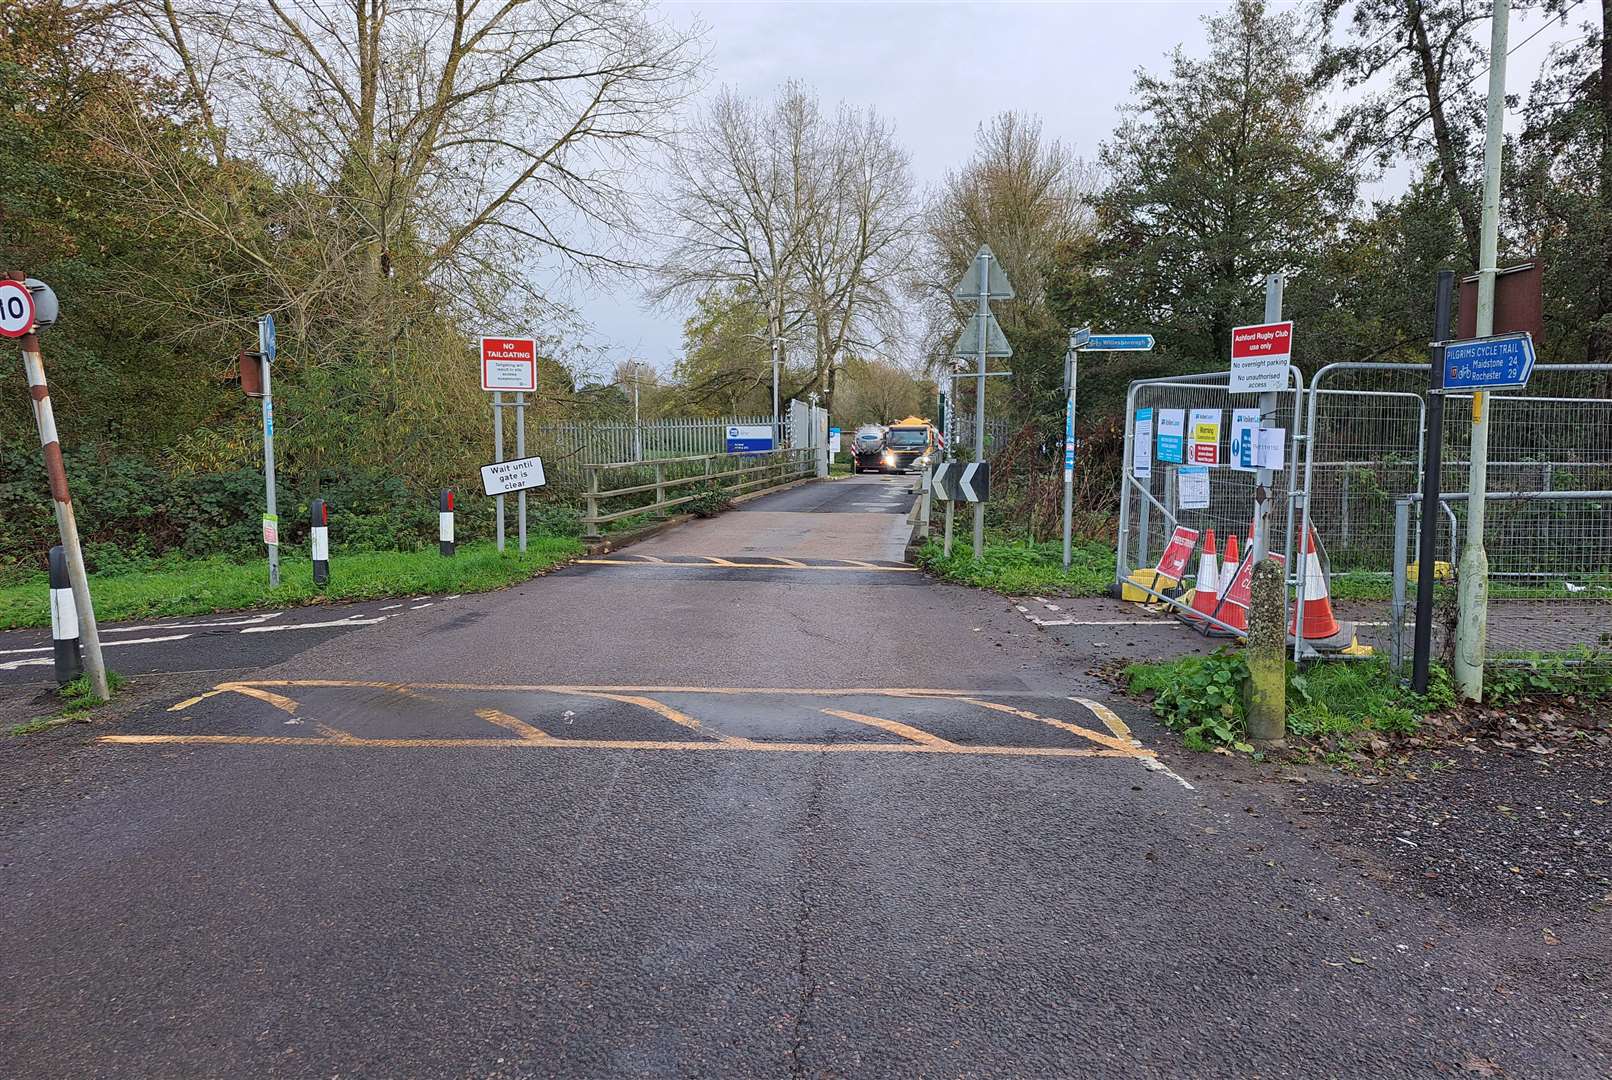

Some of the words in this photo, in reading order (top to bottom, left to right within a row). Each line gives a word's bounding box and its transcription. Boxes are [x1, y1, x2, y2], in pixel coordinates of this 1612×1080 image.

[1235, 333, 1256, 342] Ashford
[1257, 331, 1274, 340] Rugby
[1275, 330, 1289, 338] Club
[1260, 342, 1272, 350] only
[1447, 347, 1475, 360] PILGRIMS
[1476, 345, 1498, 357] CYCLE
[1499, 343, 1519, 354] TRAIL
[487, 351, 530, 359] TAILGATING
[1241, 360, 1266, 369] overnight
[1266, 358, 1288, 367] parking
[1472, 358, 1504, 369] Maidstone
[1508, 356, 1518, 367] 24
[1245, 373, 1281, 381] unauthorised
[1472, 371, 1502, 381] Rochester
[1507, 368, 1517, 379] 29
[490, 465, 511, 474] Wait
[513, 461, 533, 470] until
[499, 473, 518, 483] gate
[505, 481, 526, 490] clear
